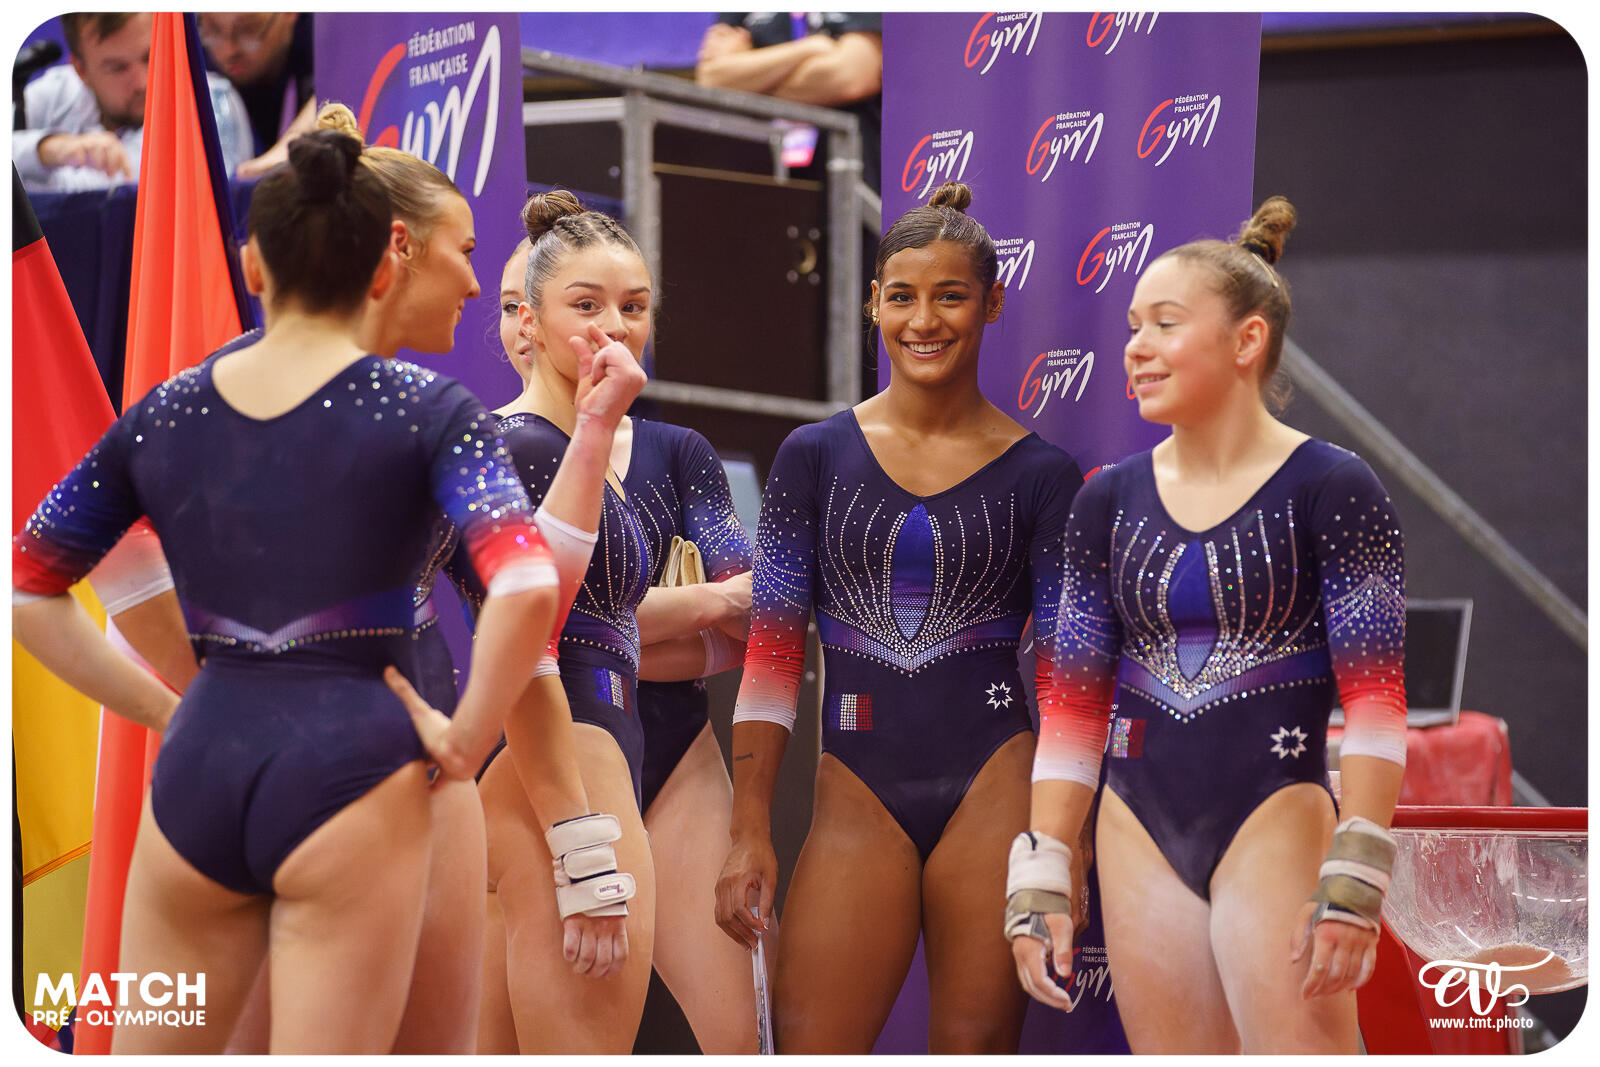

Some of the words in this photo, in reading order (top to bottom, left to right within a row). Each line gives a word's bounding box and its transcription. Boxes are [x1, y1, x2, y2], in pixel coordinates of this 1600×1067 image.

[996, 12, 1028, 23] FRANÇAISE
[408, 20, 476, 58] FÉDÉRATION
[409, 53, 468, 88] FRANÇAISE
[1174, 93, 1209, 105] FÉDÉRATION
[1174, 102, 1205, 114] FRANÇAISE
[1056, 110, 1091, 122] FÉDÉRATION
[1056, 120, 1087, 131] FRANÇAISE
[932, 129, 963, 140] FÉDÉRATION
[932, 138, 960, 149] FRANÇAISE
[1111, 221, 1141, 233] FÉDÉRATION
[1111, 230, 1138, 241] FRANÇAISE
[995, 246, 1021, 256] ANÇAISE
[1047, 348, 1081, 359] FÉDÉRATION
[1047, 356, 1077, 367] FRANÇAISE
